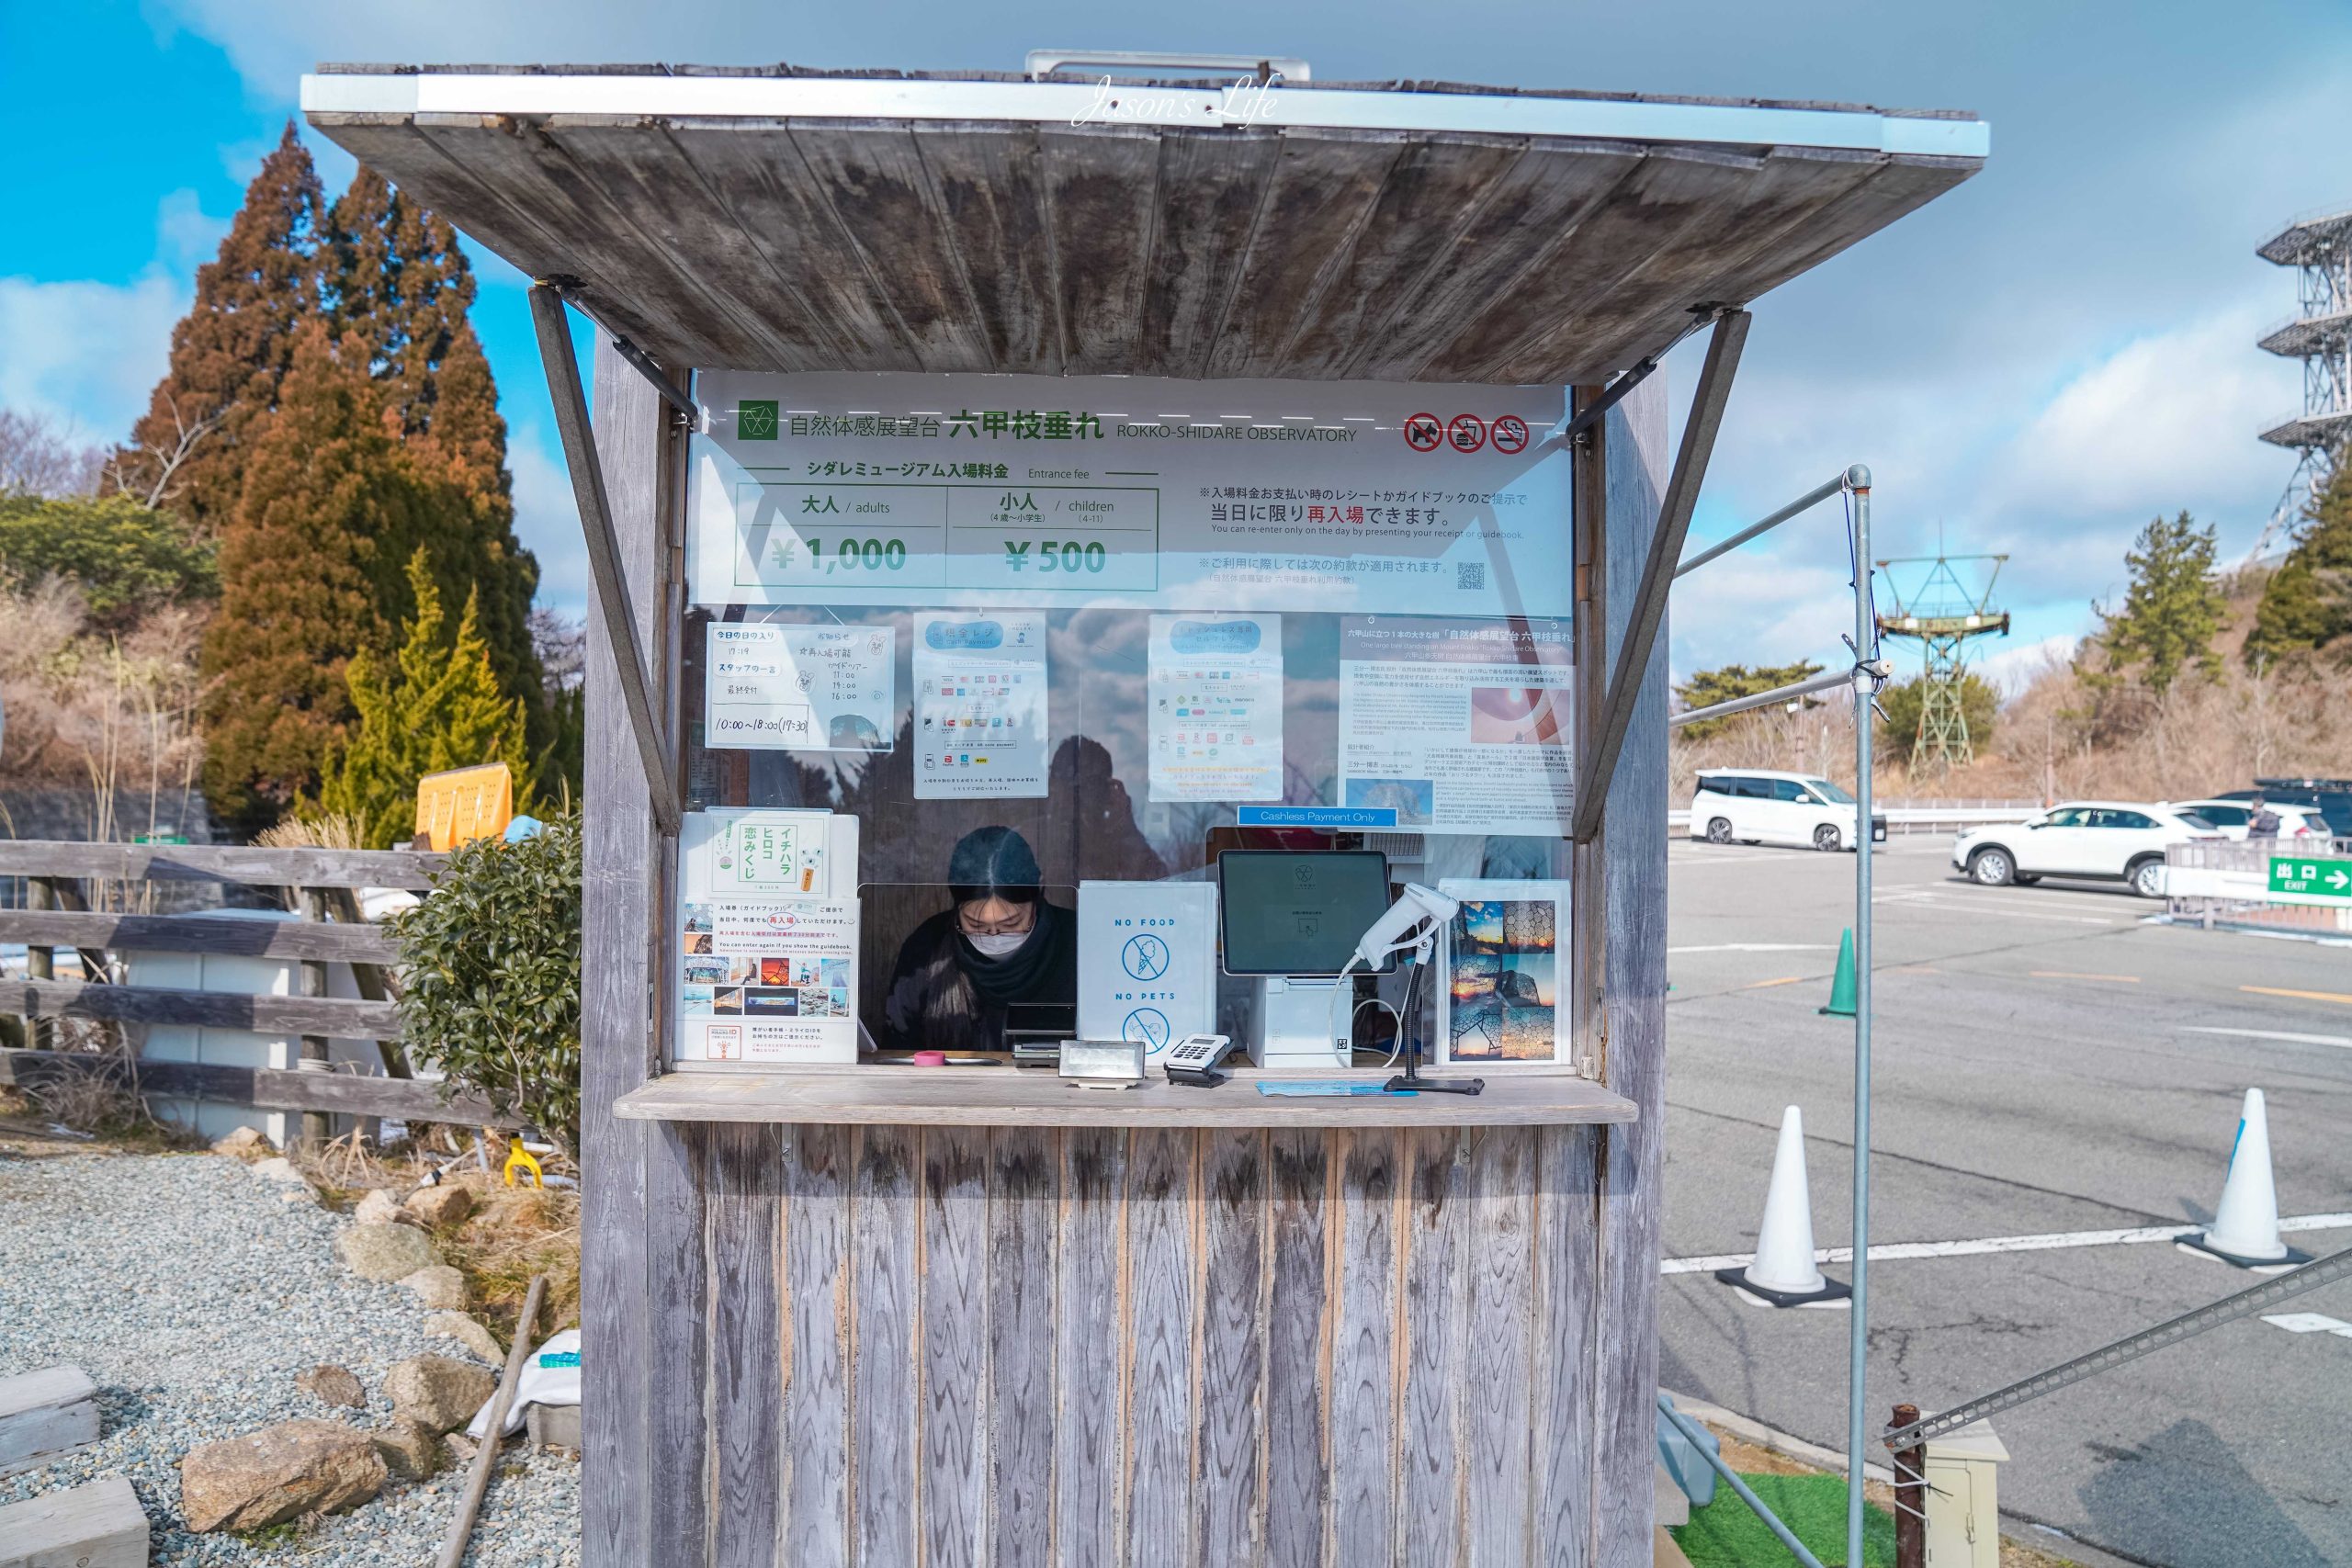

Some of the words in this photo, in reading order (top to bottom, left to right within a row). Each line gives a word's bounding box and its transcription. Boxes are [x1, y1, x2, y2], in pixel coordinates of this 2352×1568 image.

[790, 416, 941, 438] 自然体感展望台
[949, 410, 1104, 440] 六甲枝垂れ
[1117, 424, 1243, 439] ROKKO-SHIDARE
[1247, 426, 1358, 442] OBSERVATORY
[808, 461, 1010, 479] シダレミュージアム入場料金
[1029, 468, 1072, 479] Entrance
[1074, 468, 1091, 479] fee
[801, 494, 841, 514] 大人
[855, 502, 890, 513] adults
[1000, 492, 1038, 512] 小人
[1069, 501, 1114, 512] children
[1211, 502, 1448, 526] 当日に限り再入場できます。
[1211, 525, 1228, 534] You
[1248, 526, 1283, 535] re-enter
[1284, 525, 1303, 536] only
[1318, 526, 1333, 535] the
[1335, 527, 1351, 537] day
[1352, 527, 1363, 537] by
[1365, 528, 1411, 538] presenting
[1413, 530, 1431, 539] your
[1434, 529, 1464, 539] receipt
[1477, 529, 1524, 540] guidebook.
[717, 631, 775, 640] 今日の日の入り
[817, 632, 850, 641] お知らせ
[1374, 641, 1389, 649] large
[1403, 642, 1430, 651] standing
[718, 663, 776, 674] スタッフの一言
[833, 671, 855, 679] 11:00
[728, 684, 758, 695] 最終受付
[831, 693, 858, 701] 16:00
[1261, 811, 1306, 821] Cashless
[1307, 811, 1351, 823] Payment
[1352, 813, 1375, 823] Only
[763, 827, 774, 860] ヒロコ
[743, 826, 757, 880] 恋みくじ
[780, 828, 792, 875] イチハラ
[2276, 863, 2317, 881] 出口
[2283, 879, 2308, 891] EXIT
